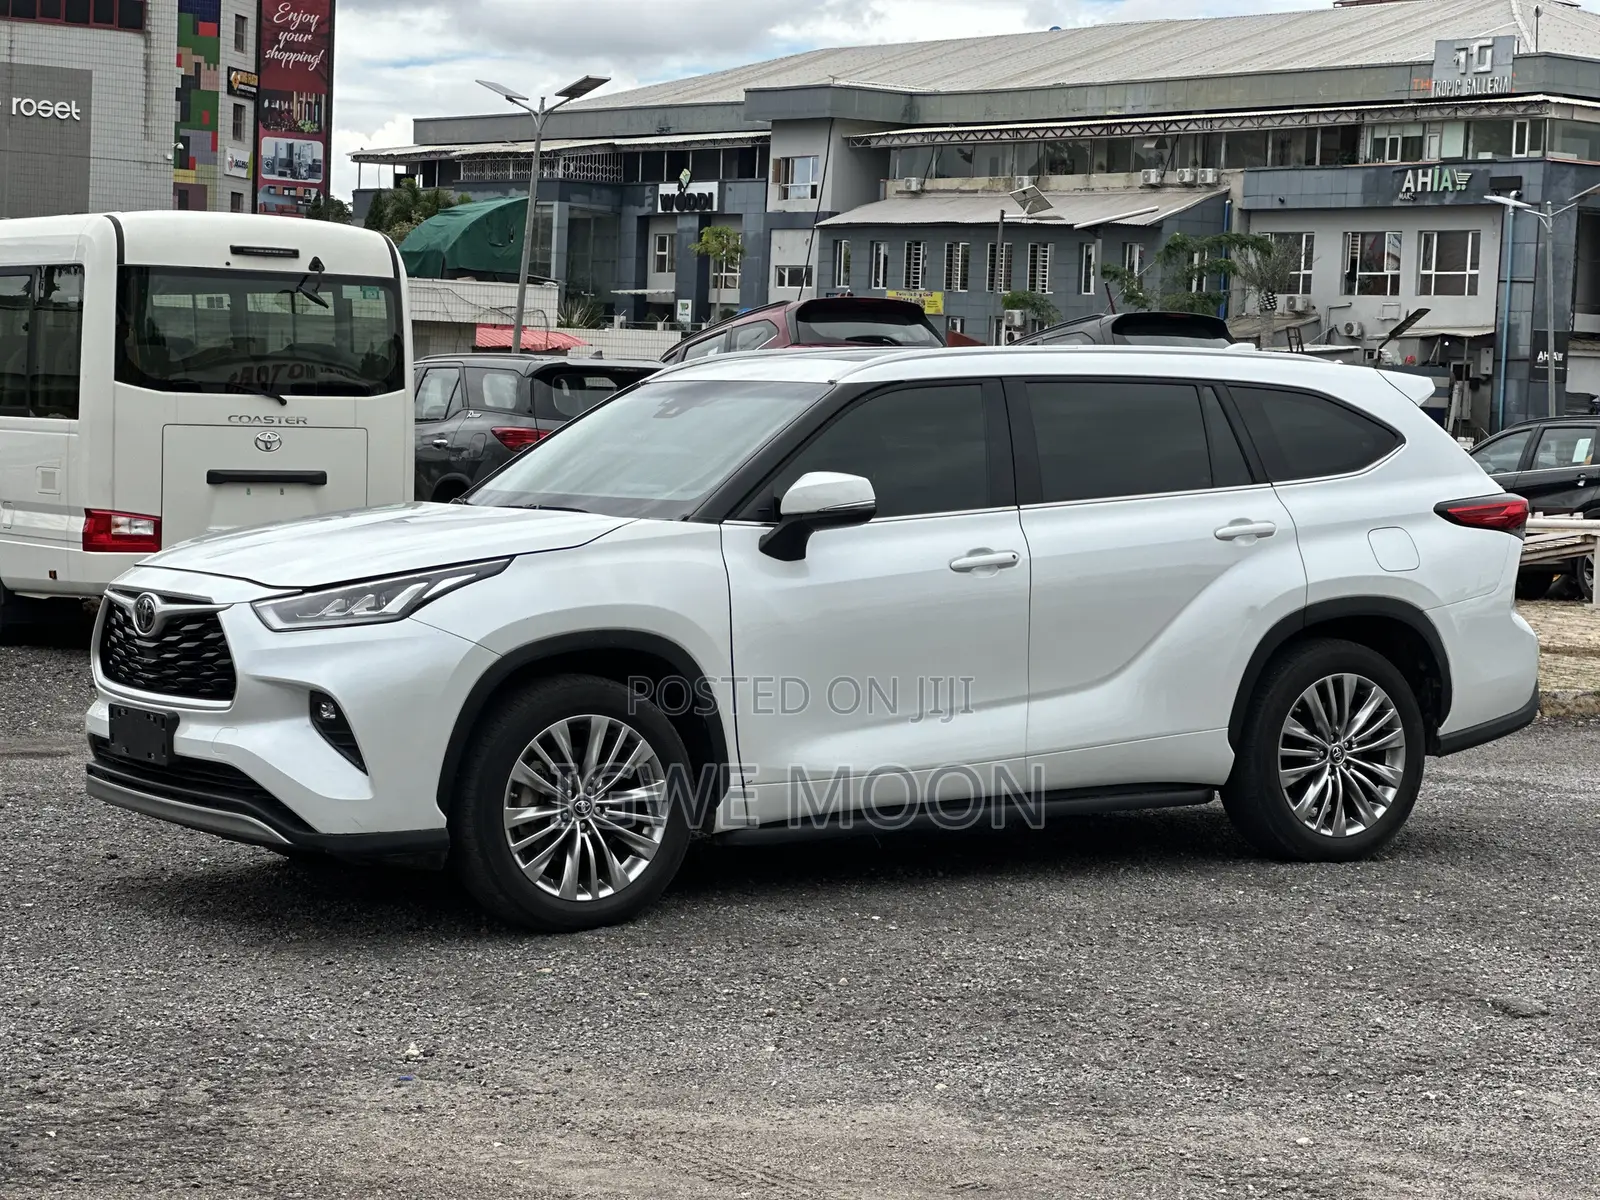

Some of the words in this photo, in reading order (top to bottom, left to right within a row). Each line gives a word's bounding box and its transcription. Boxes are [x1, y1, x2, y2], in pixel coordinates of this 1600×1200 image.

[273, 2, 320, 32] Enjoy
[279, 31, 313, 49] your
[265, 44, 325, 71] shopping!
[1432, 78, 1461, 98] TROPIC
[1465, 76, 1508, 95] GALLERIA
[12, 97, 81, 121] roset
[659, 191, 714, 212] WODDI
[1537, 351, 1558, 362] AHA
[228, 415, 308, 425] COASTER
